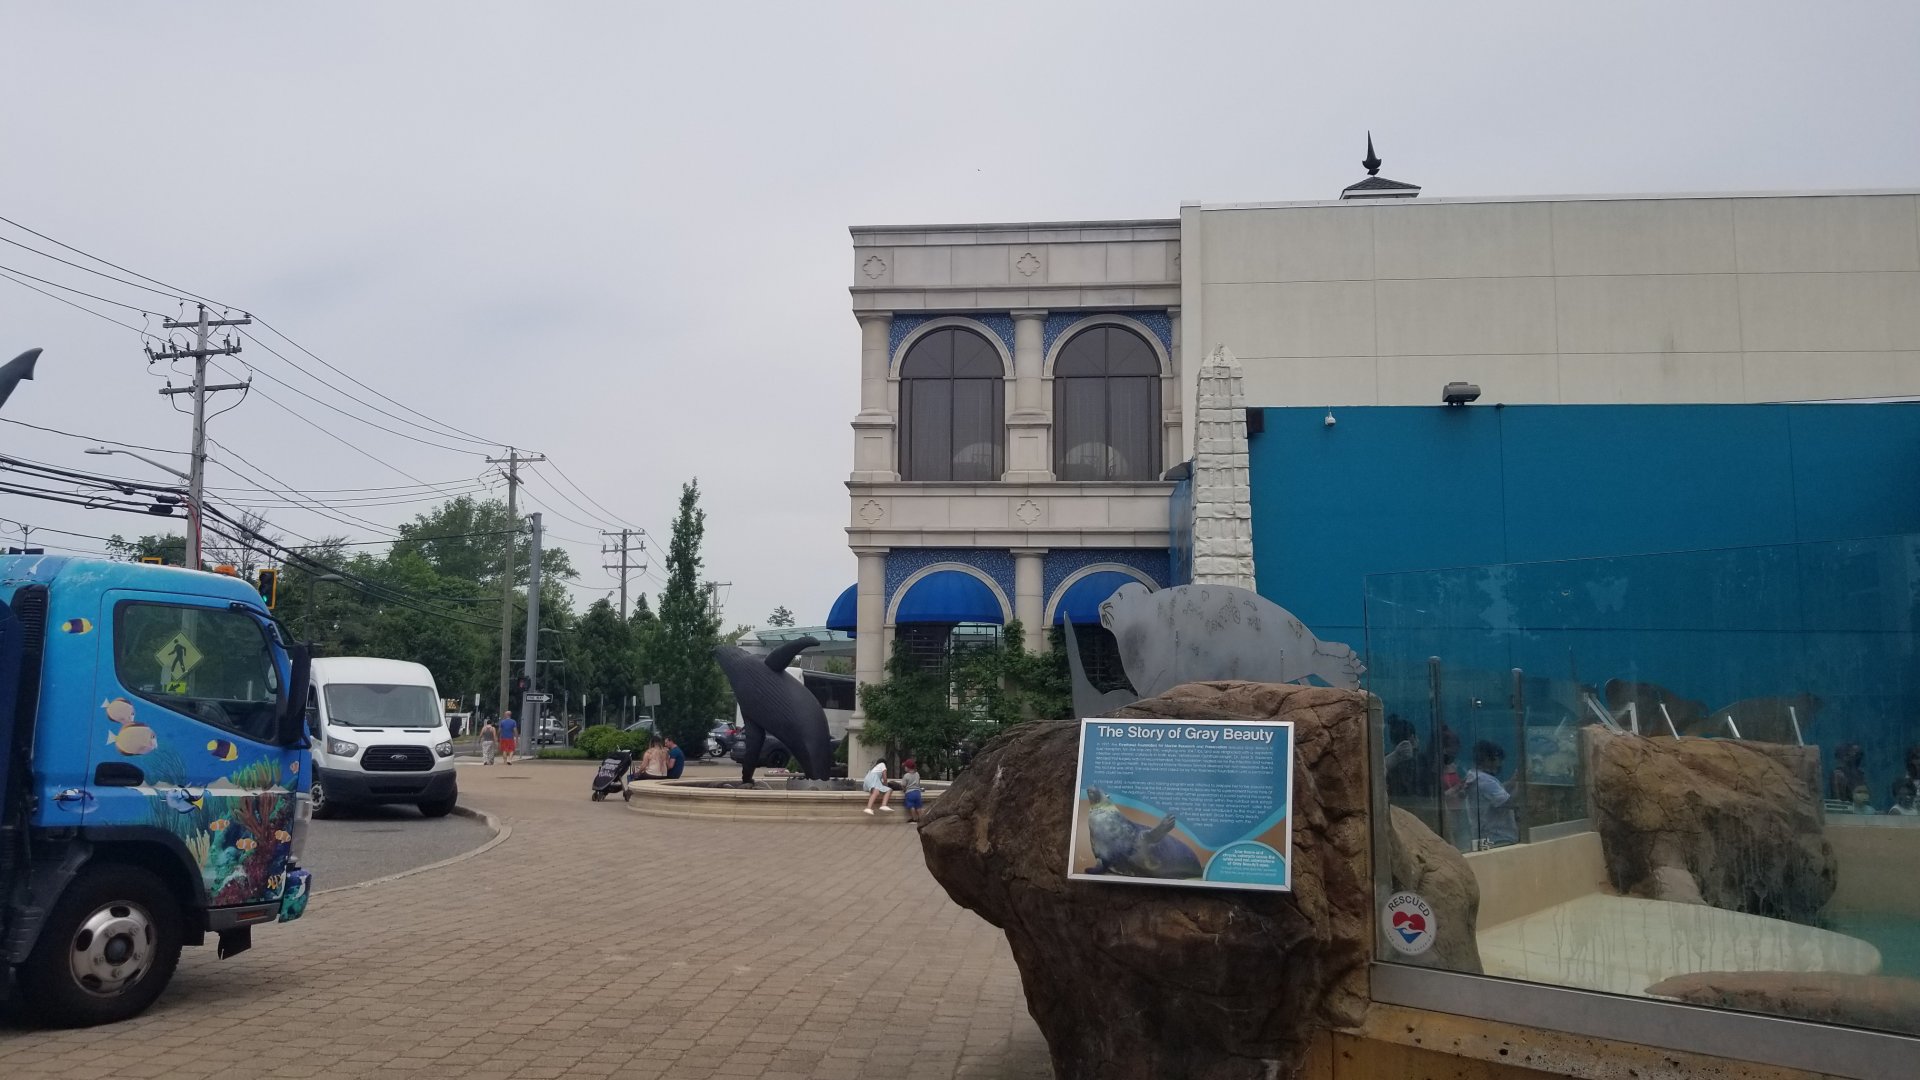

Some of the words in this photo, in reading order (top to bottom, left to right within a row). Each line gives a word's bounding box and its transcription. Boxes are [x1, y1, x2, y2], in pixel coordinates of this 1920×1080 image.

[1097, 725, 1124, 738] The
[1127, 726, 1165, 741] Story
[1168, 727, 1182, 739] of
[1185, 727, 1219, 742] Gray
[1223, 728, 1273, 743] Beauty
[1388, 896, 1430, 916] RESCUED
